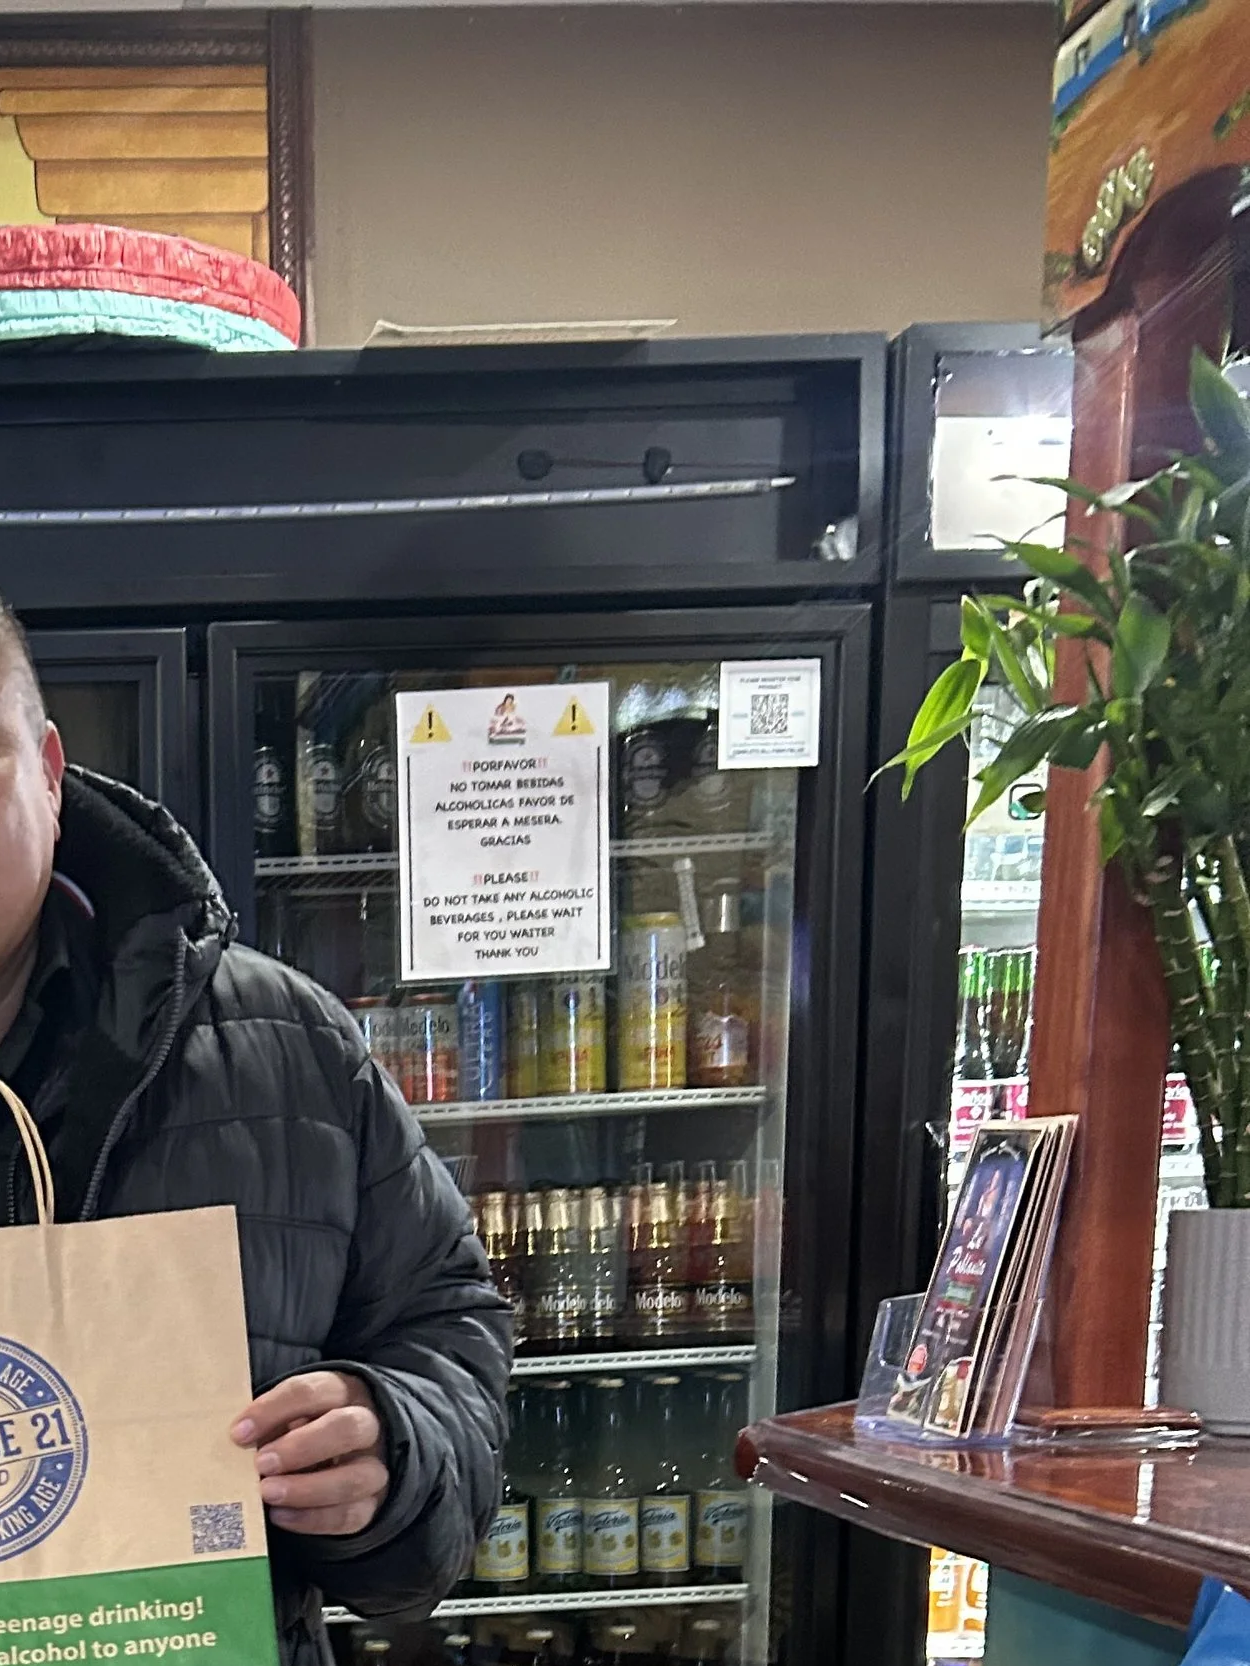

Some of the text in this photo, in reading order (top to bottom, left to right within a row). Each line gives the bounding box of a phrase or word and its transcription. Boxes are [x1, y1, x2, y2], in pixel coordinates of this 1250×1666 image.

[450, 776, 564, 793] NO TOMAR BEBIDAS
[435, 794, 575, 812] ALCOHOLICAS FAVOR DE
[448, 817, 498, 831] ESPERAR
[501, 817, 510, 827] A
[480, 834, 531, 848] GRACIAS
[423, 888, 594, 908] DO NOT TAKE ANY ALCOHOLIC
[430, 911, 495, 926] BEVERAGES
[506, 909, 548, 922] PLEASE
[551, 907, 583, 919] WAIT
[458, 927, 555, 942] FOR YOU WAITER
[475, 947, 539, 960] THANK YOU
[635, 1291, 681, 1309] Modelo
[695, 1287, 742, 1305] Modelo
[31, 1408, 71, 1450] 21
[30, 1476, 61, 1512] AGE
[89, 1596, 204, 1625] drinking!
[91, 1641, 118, 1659] to
[124, 1631, 217, 1658] anyone
